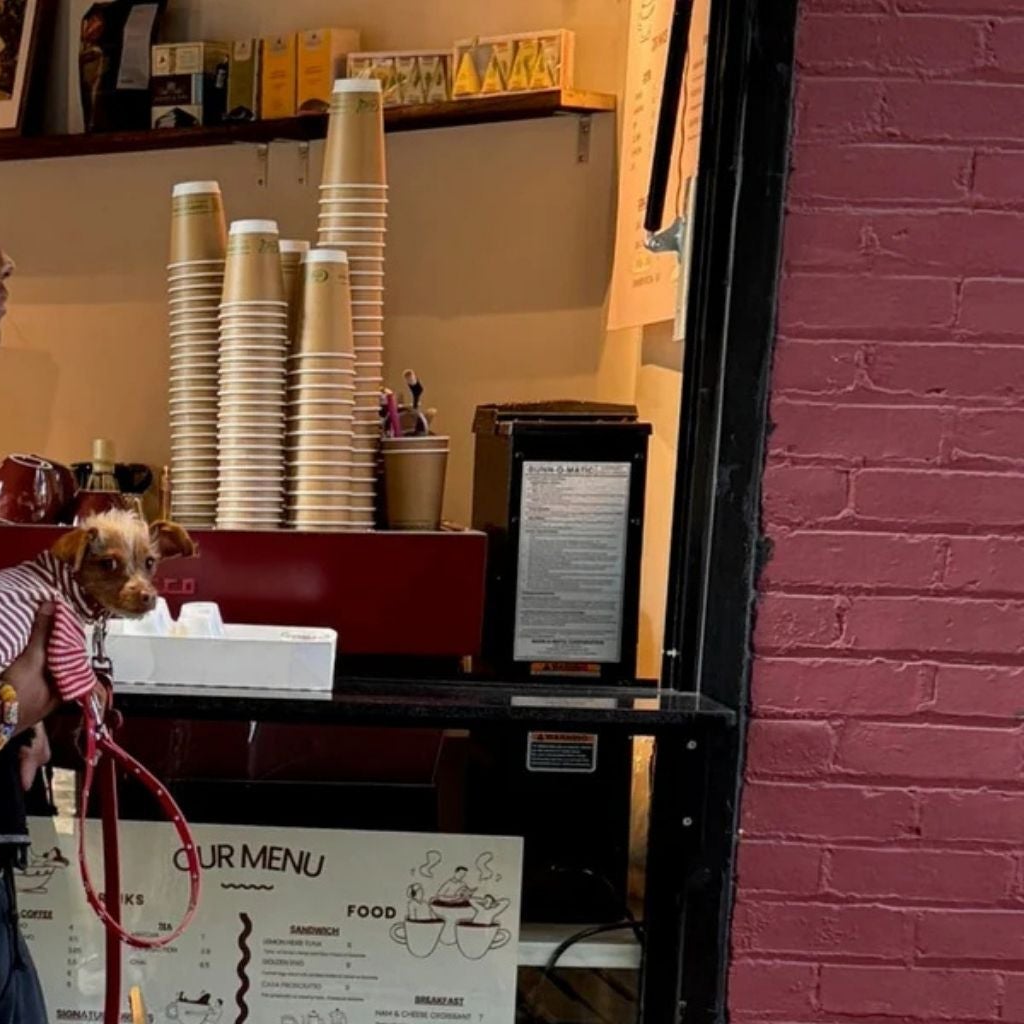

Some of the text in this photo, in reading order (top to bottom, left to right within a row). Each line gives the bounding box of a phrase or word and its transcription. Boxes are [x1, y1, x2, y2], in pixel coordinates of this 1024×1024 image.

[173, 844, 325, 877] OUR MENU
[347, 904, 397, 919] FOOD
[289, 925, 340, 937] SANDWICH
[415, 996, 464, 1007] BREAKFAST
[401, 1011, 428, 1019] CHEESE
[430, 1012, 471, 1020] CROISSANT
